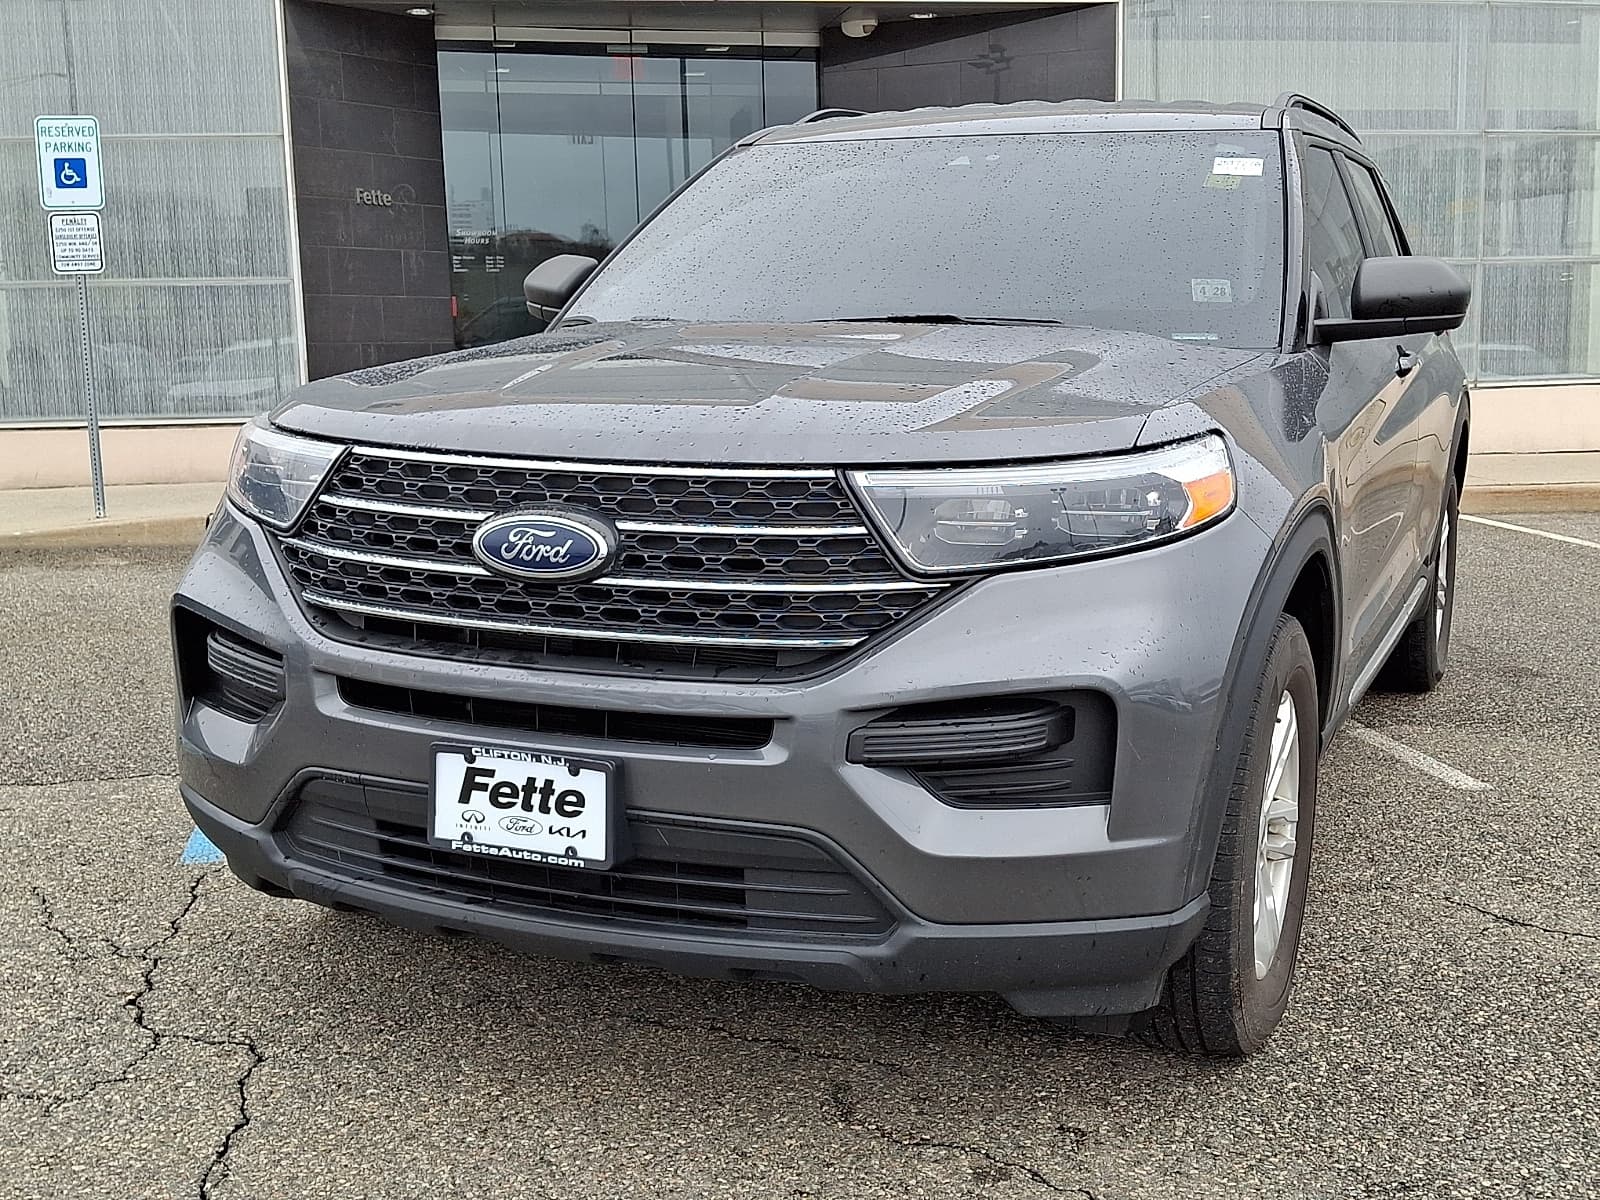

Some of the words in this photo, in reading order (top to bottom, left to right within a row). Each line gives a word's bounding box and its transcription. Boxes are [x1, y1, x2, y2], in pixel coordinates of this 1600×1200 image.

[40, 126, 95, 137] RESERVED
[45, 141, 92, 152] PARKING
[356, 187, 392, 206] Fette
[464, 237, 490, 245] HOURS
[1212, 286, 1226, 296] 28
[501, 527, 573, 564] Ford
[541, 756, 570, 767] N.J.
[458, 766, 586, 818] Fette
[506, 817, 536, 834] Ford
[451, 841, 586, 868] FetteAuto.com
